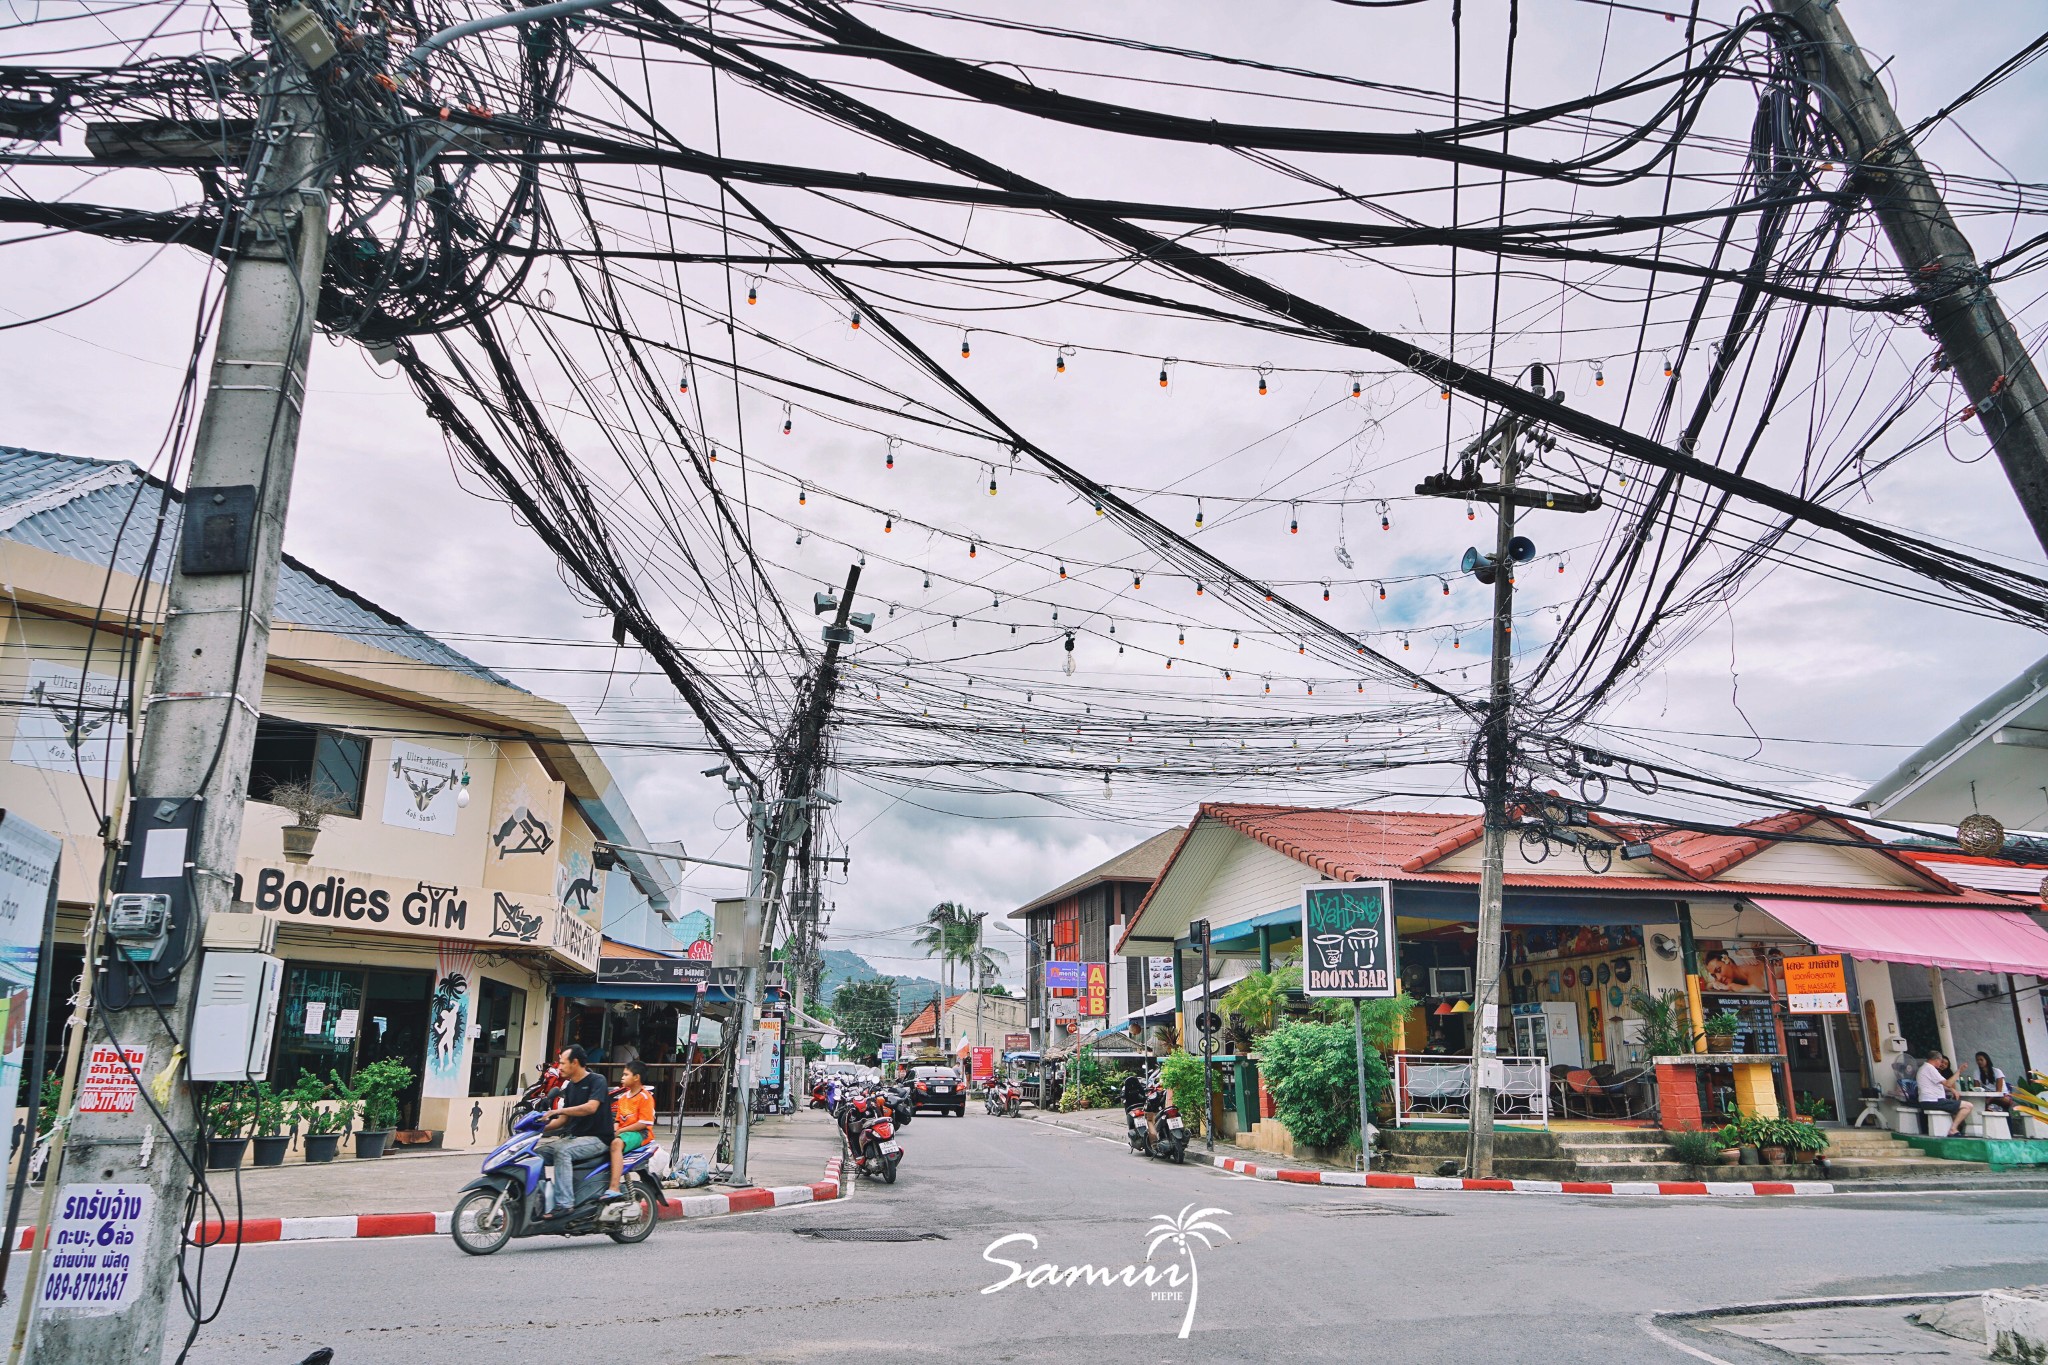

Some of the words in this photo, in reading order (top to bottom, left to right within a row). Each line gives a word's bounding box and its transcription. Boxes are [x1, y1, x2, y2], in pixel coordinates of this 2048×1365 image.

[53, 674, 78, 690] Ultra
[49, 745, 65, 759] Koh
[70, 751, 96, 762] Smui
[406, 751, 423, 764] Ultra
[426, 756, 448, 769] Bodies
[405, 807, 417, 820] Koh
[419, 812, 437, 822] Samui
[254, 867, 391, 923] Bodies
[402, 881, 468, 931] GYM
[673, 968, 683, 976] BE
[684, 969, 705, 977] MINE
[1089, 967, 1104, 984] A
[1310, 969, 1387, 989] ROOTS.BAR
[1088, 985, 1105, 997] TO
[1090, 998, 1104, 1015] B
[1793, 1020, 1809, 1029] OPEN
[62, 1188, 142, 1220] รถรับจ้าง
[45, 1273, 128, 1301] 089-8702367
